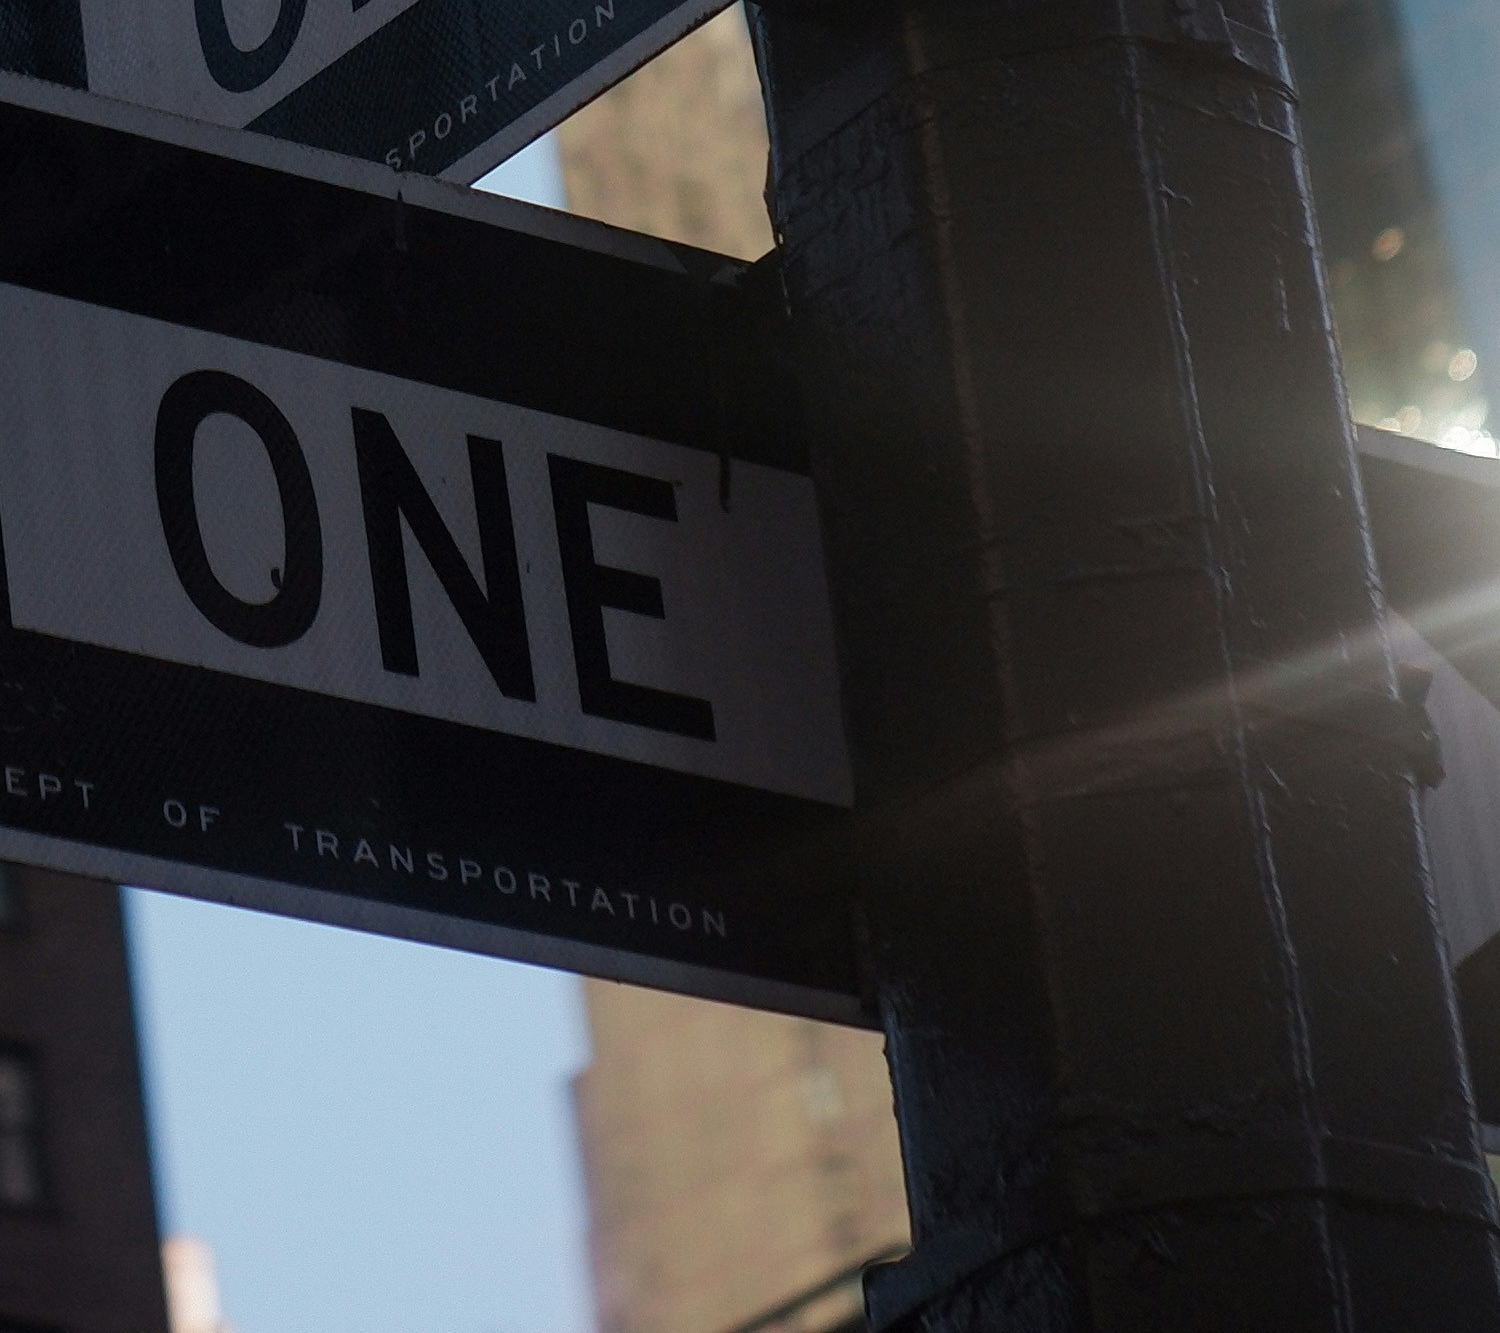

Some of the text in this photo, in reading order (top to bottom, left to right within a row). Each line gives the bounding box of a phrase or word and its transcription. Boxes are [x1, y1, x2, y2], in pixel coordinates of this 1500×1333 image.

[152, 367, 717, 743] ONE
[162, 797, 221, 835] OF
[282, 821, 730, 939] TRANSPORTATION
